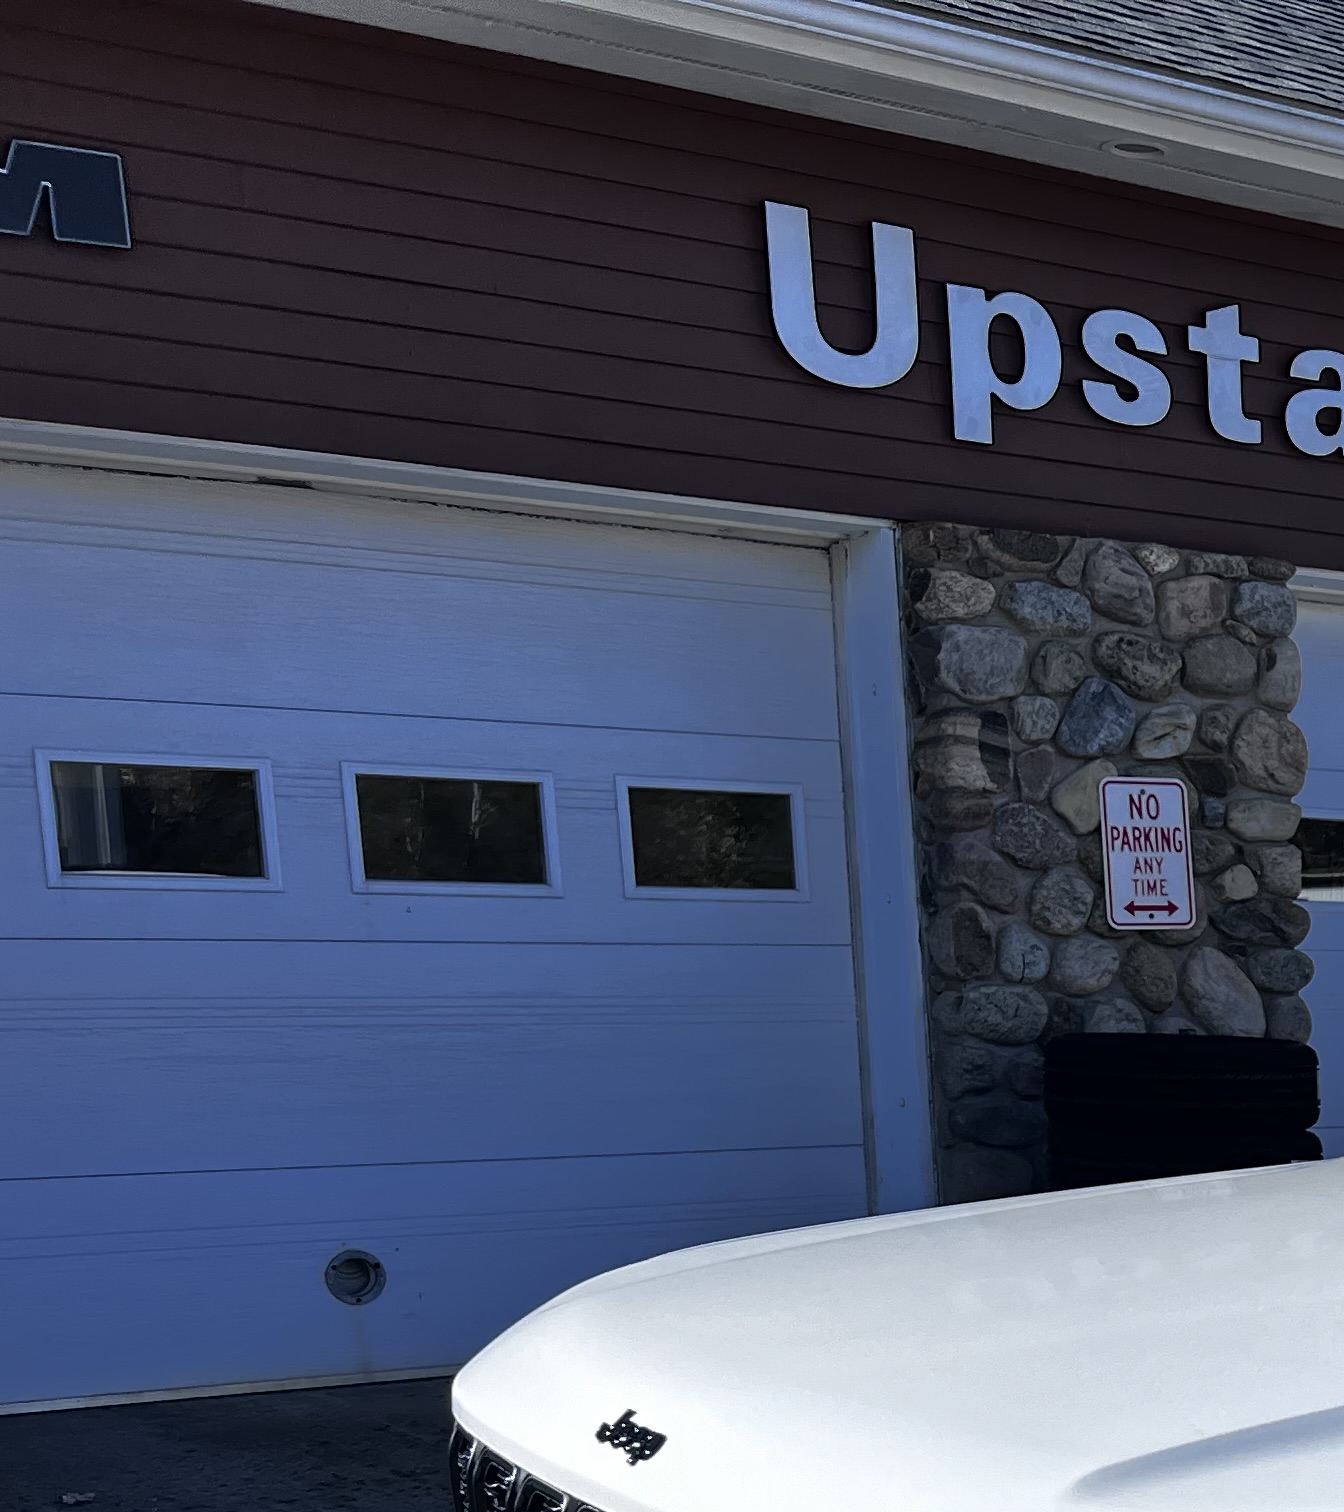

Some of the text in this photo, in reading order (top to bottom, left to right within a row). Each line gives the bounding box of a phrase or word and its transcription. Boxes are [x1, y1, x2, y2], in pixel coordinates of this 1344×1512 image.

[1129, 794, 1159, 820] NO
[1110, 826, 1183, 853] PARKING
[1133, 856, 1163, 875] ANY
[1131, 878, 1169, 897] TIME
[594, 1408, 668, 1466] Jeep
